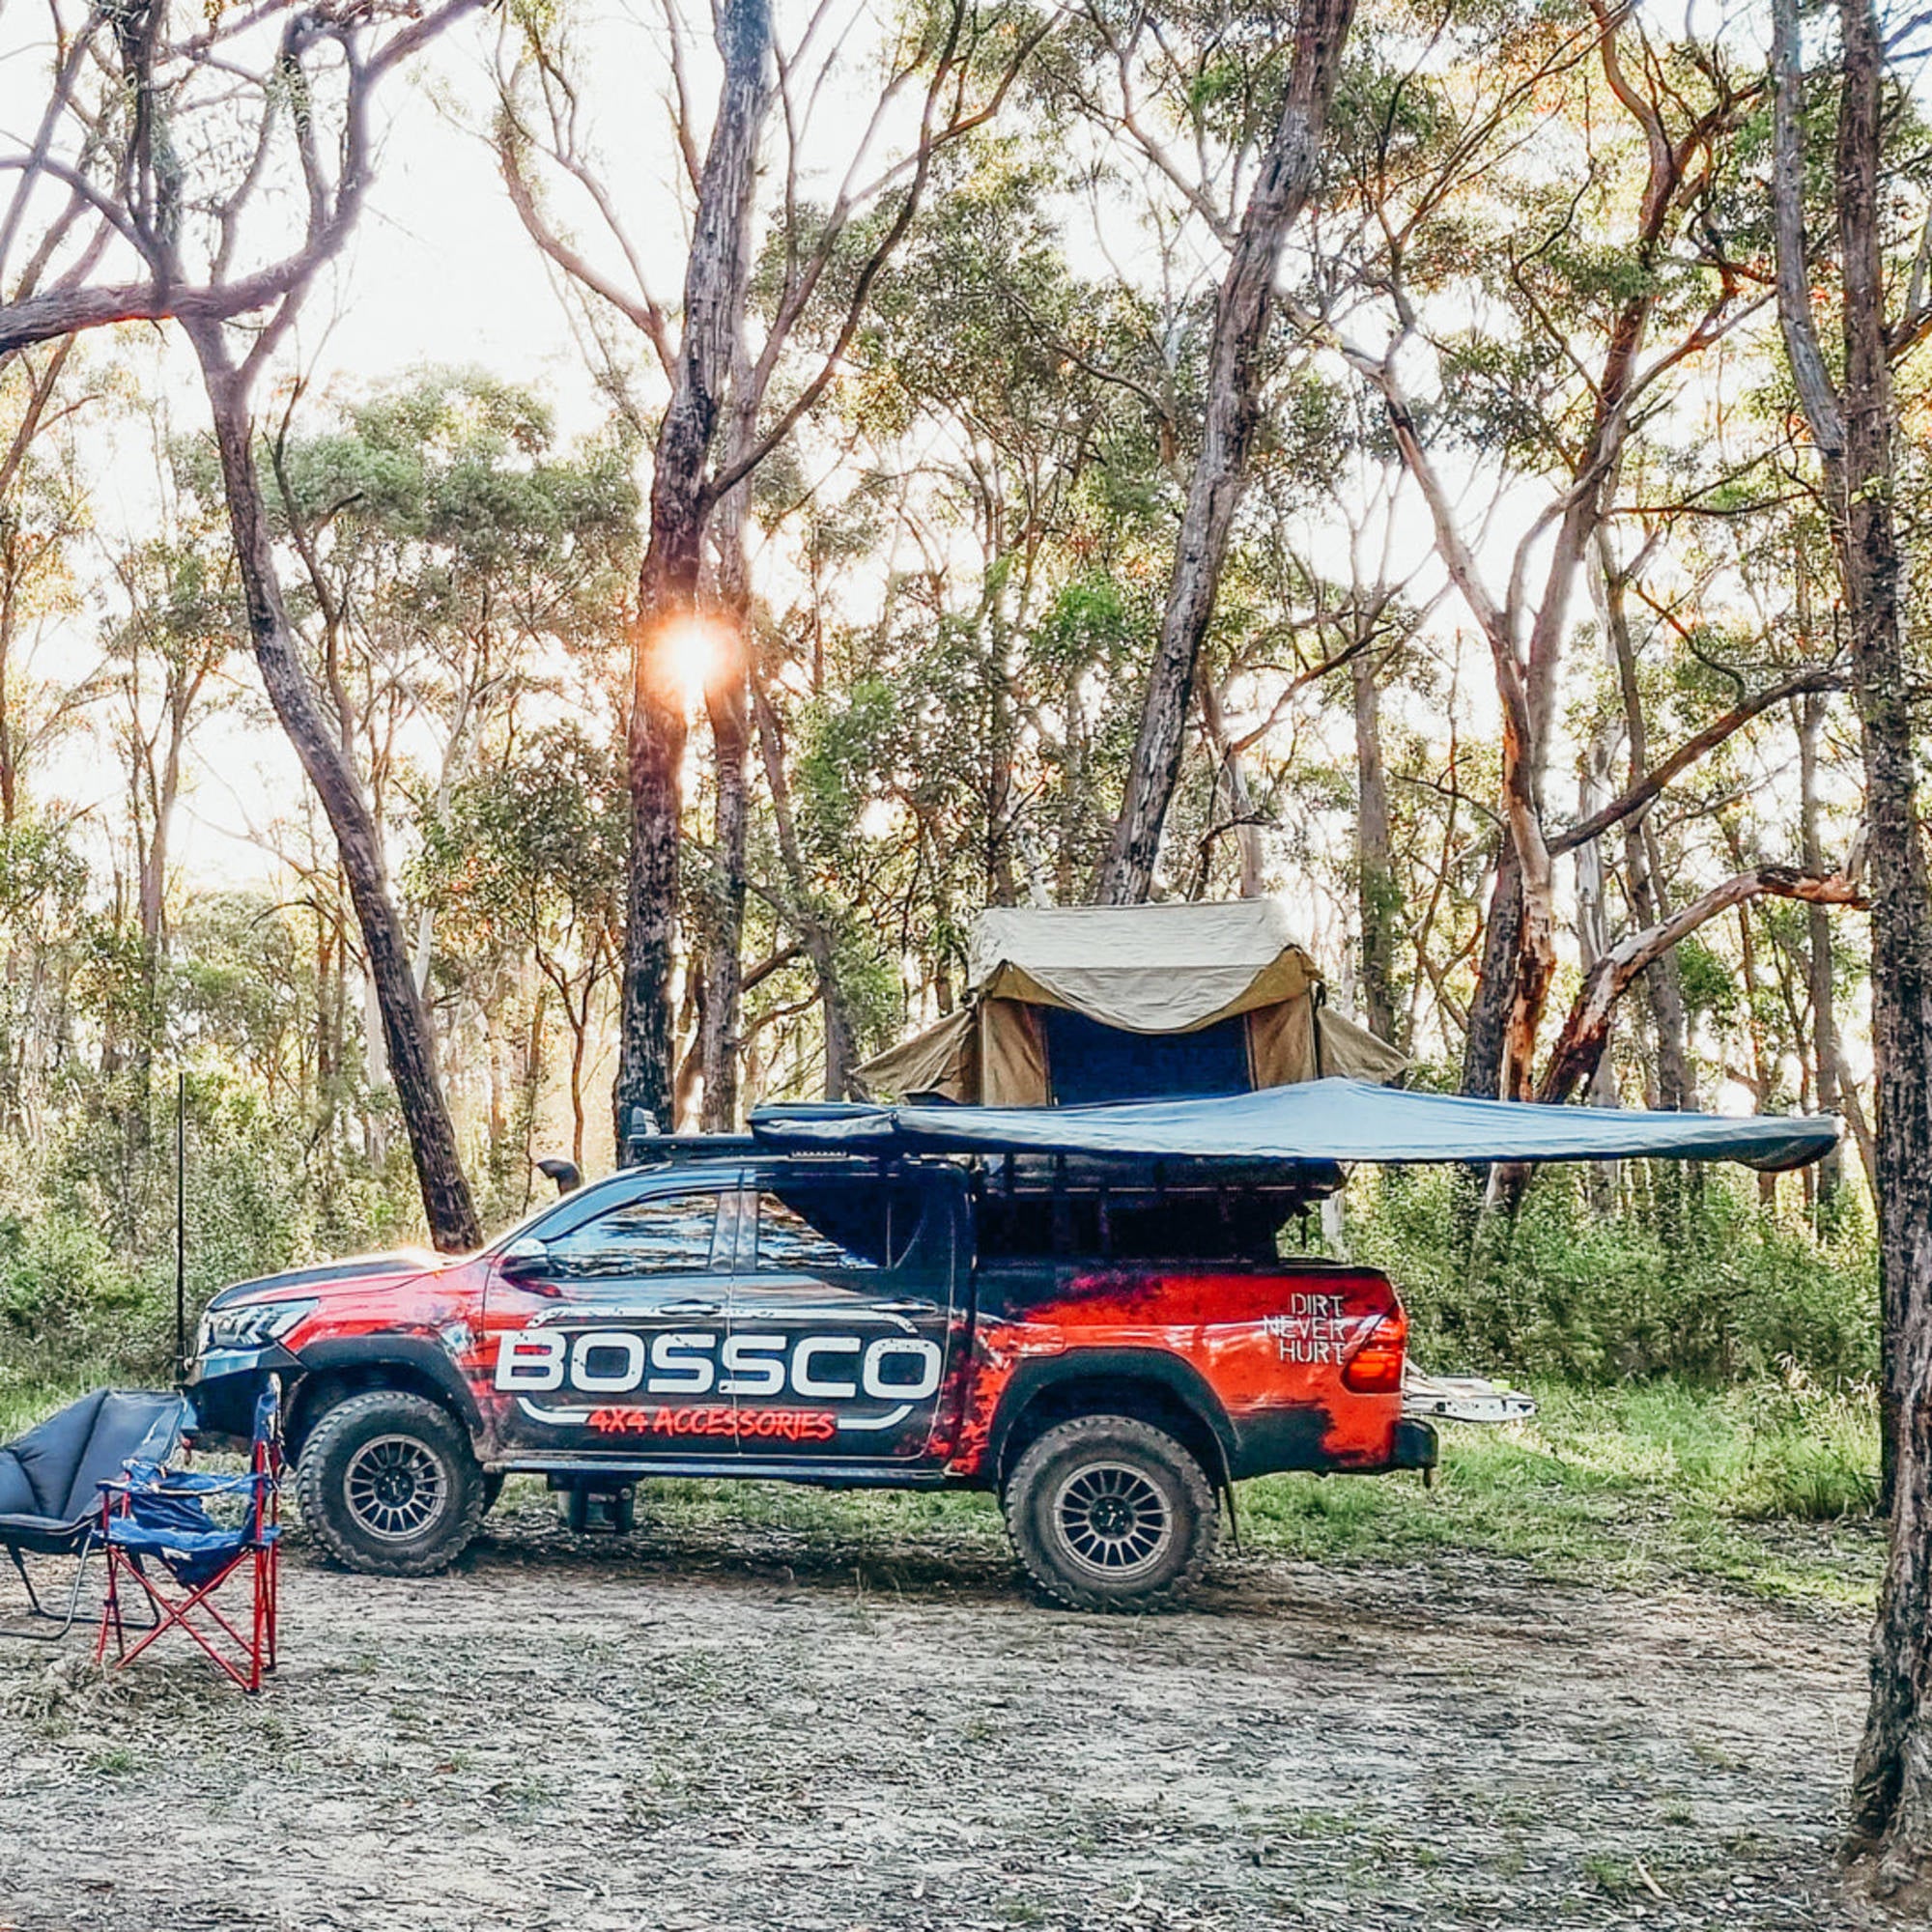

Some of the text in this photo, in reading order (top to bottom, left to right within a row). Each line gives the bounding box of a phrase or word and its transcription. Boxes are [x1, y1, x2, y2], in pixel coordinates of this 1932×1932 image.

[1291, 1293, 1345, 1317] DIRT
[1263, 1315, 1346, 1341] NEVER
[494, 1328, 942, 1400] BOSSCO
[1279, 1339, 1346, 1366] HURT
[586, 1406, 647, 1434] 4X4
